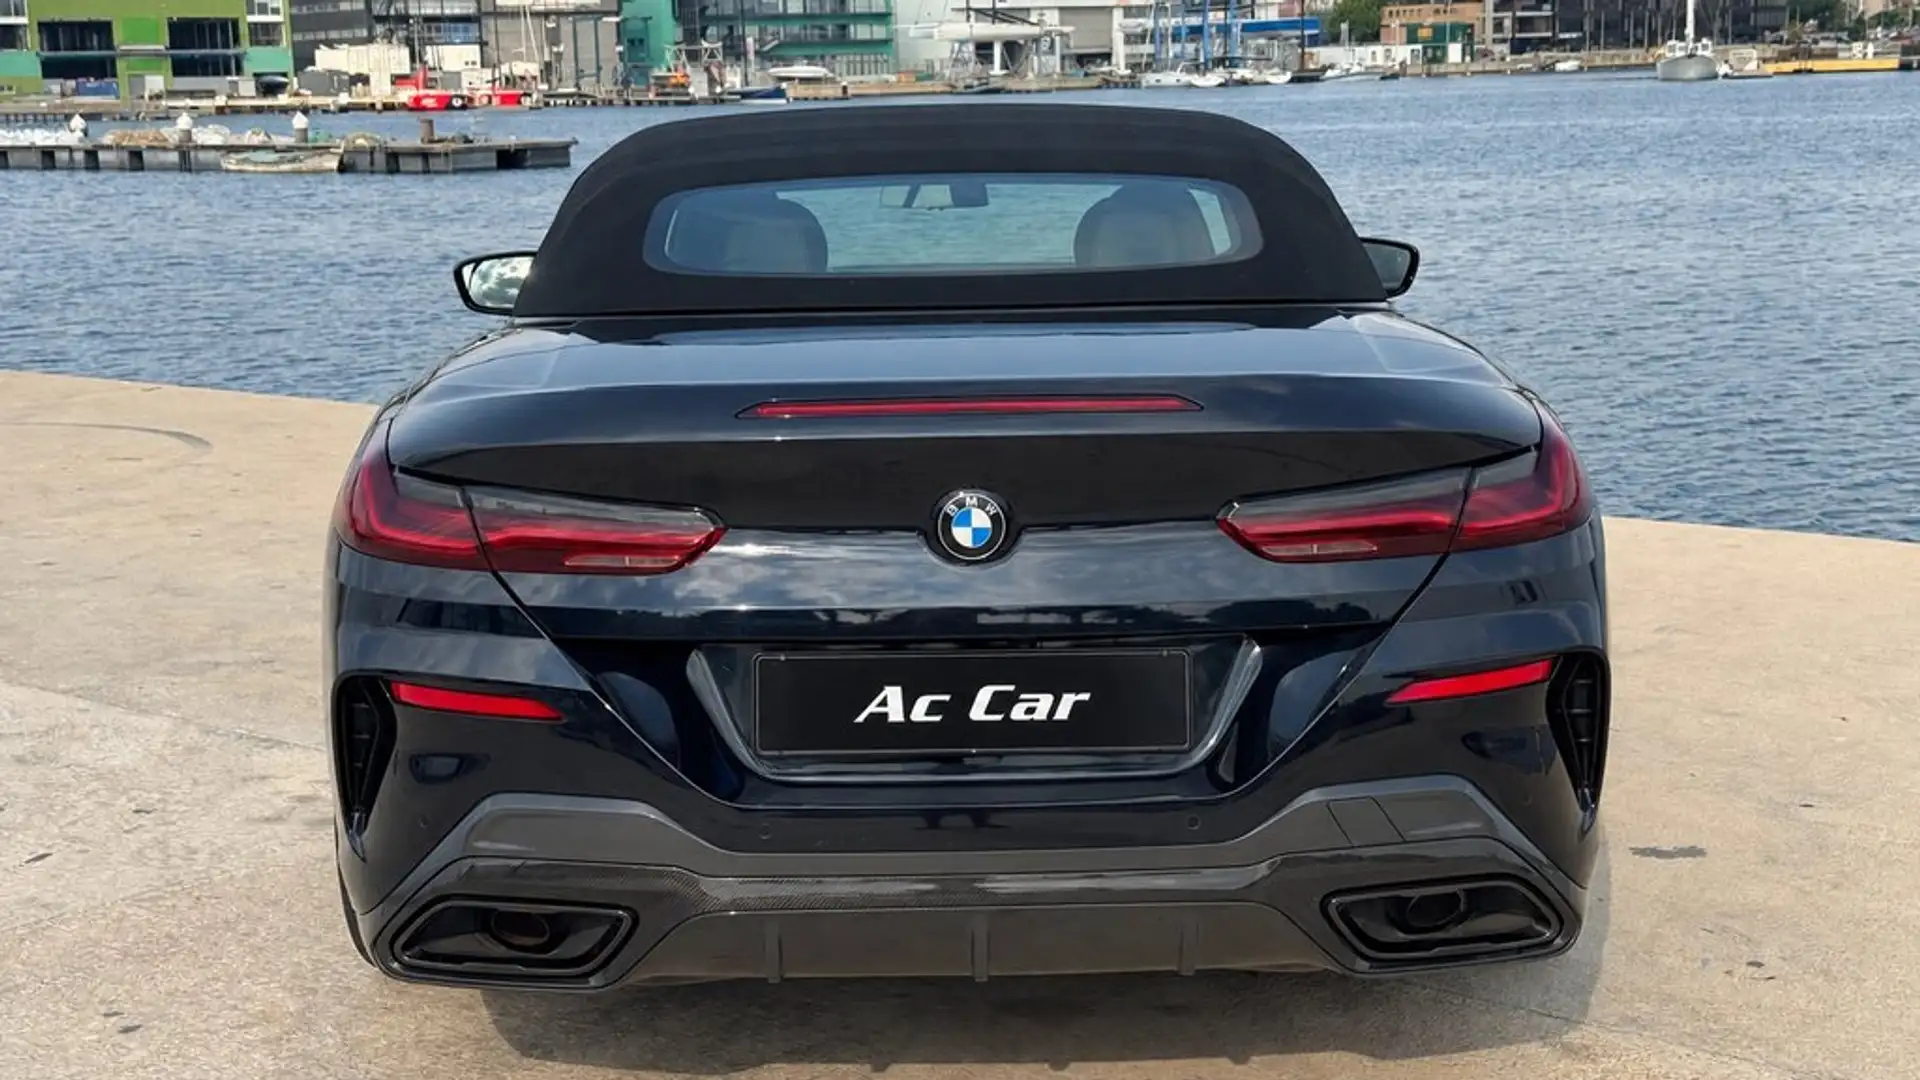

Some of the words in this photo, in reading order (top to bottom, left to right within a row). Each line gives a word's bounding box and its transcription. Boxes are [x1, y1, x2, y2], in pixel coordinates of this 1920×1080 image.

[946, 496, 997, 516] BMW
[853, 685, 951, 723] Ac
[969, 685, 1091, 721] Car
